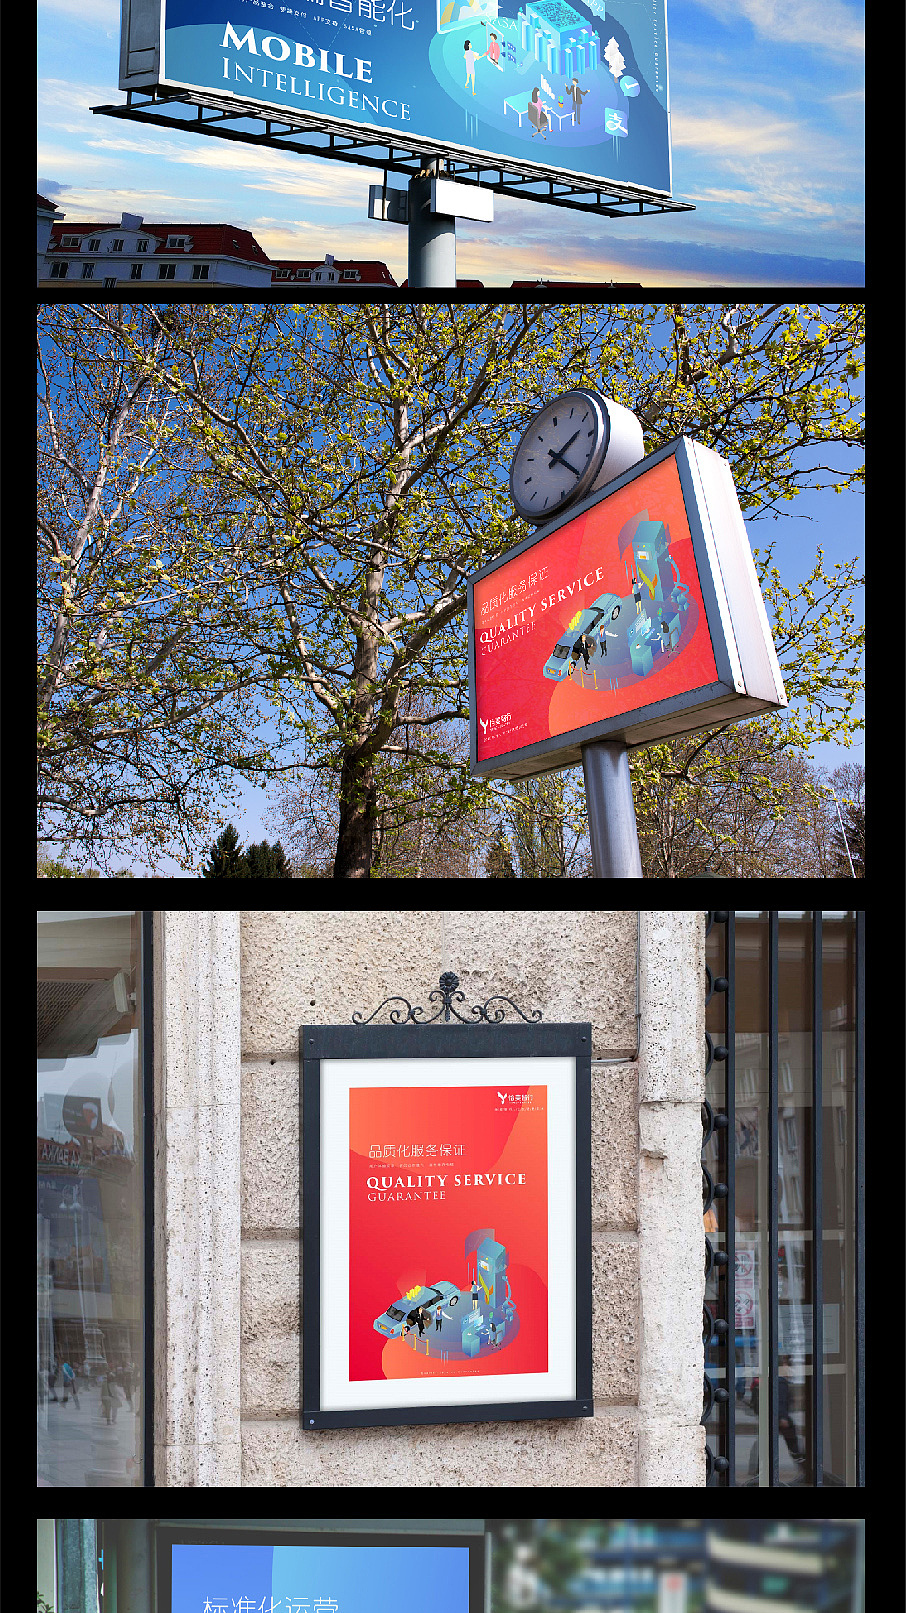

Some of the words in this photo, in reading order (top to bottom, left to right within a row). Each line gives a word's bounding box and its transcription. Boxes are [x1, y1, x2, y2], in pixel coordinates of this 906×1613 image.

[480, 603, 536, 643] QUALITY
[540, 567, 604, 612] SERVICE
[369, 1144, 466, 1158] 品质化服务保证
[367, 1175, 448, 1191] QUALITY
[454, 1174, 526, 1186] SERVICE
[367, 1191, 446, 1202] GUARANTEE
